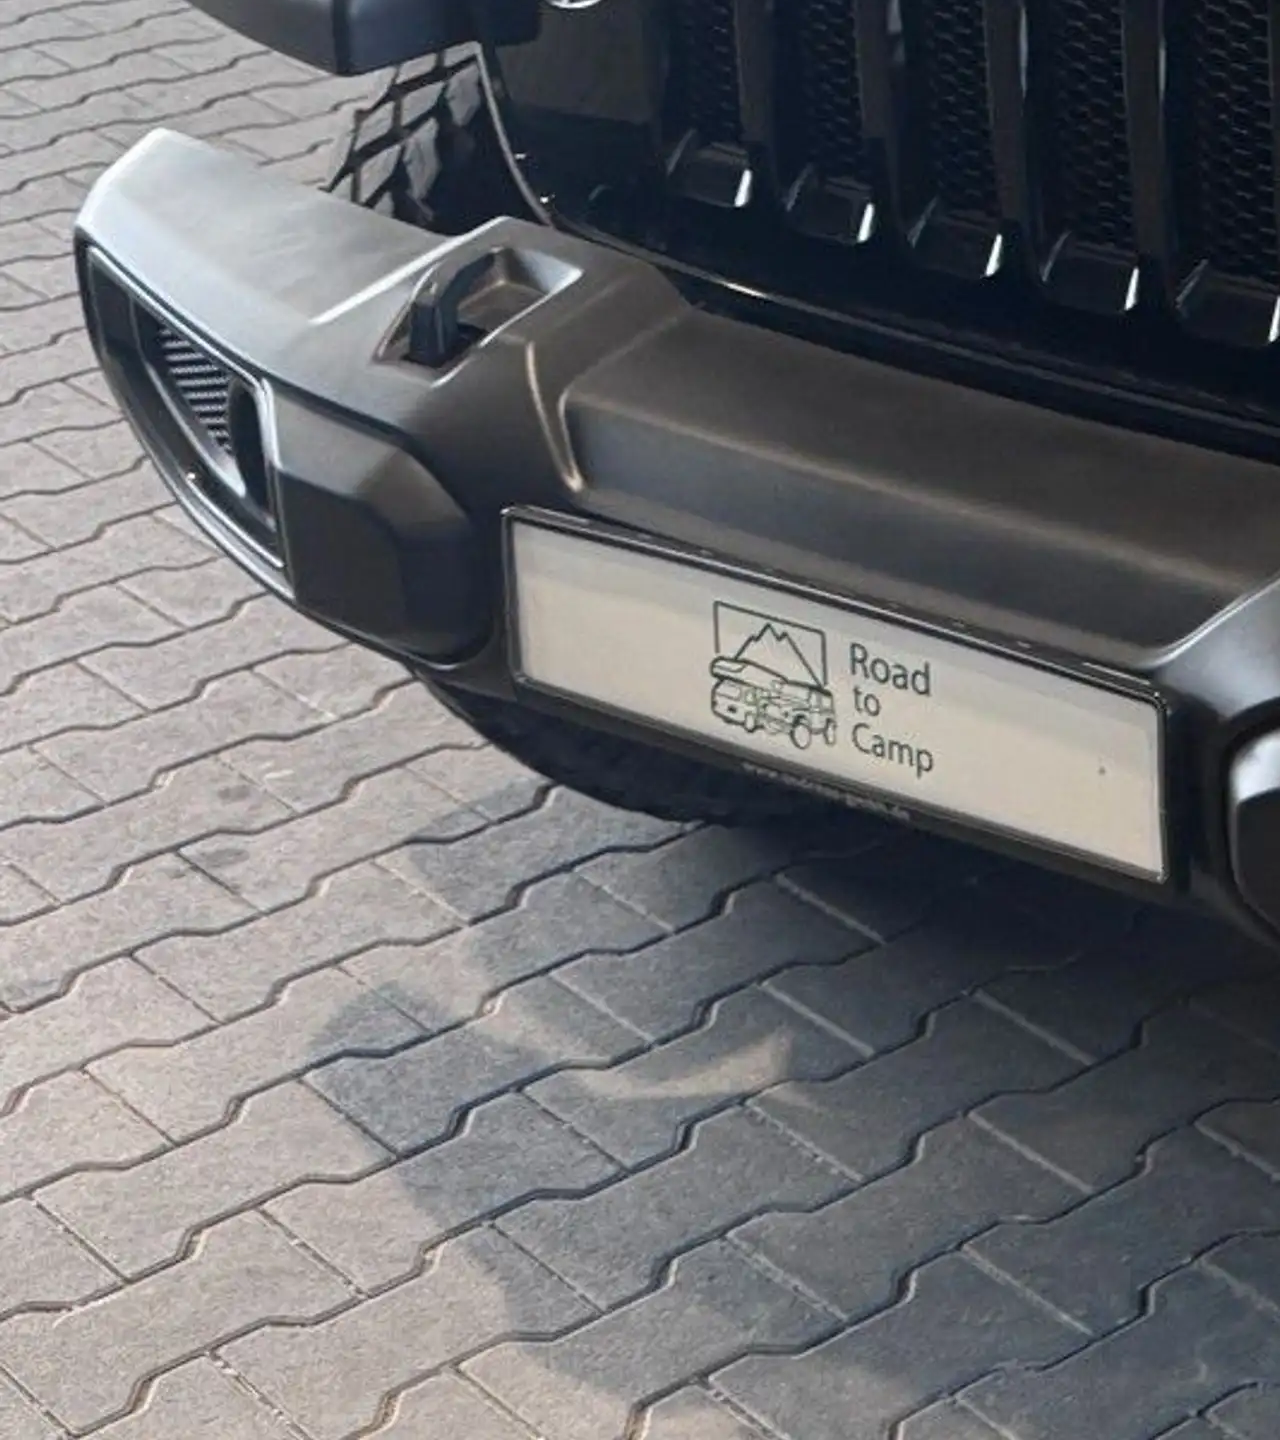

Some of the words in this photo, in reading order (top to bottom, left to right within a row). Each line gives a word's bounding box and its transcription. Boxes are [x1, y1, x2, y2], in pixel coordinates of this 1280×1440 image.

[850, 641, 931, 697] Road
[853, 686, 882, 717] to
[851, 722, 934, 780] Camp
